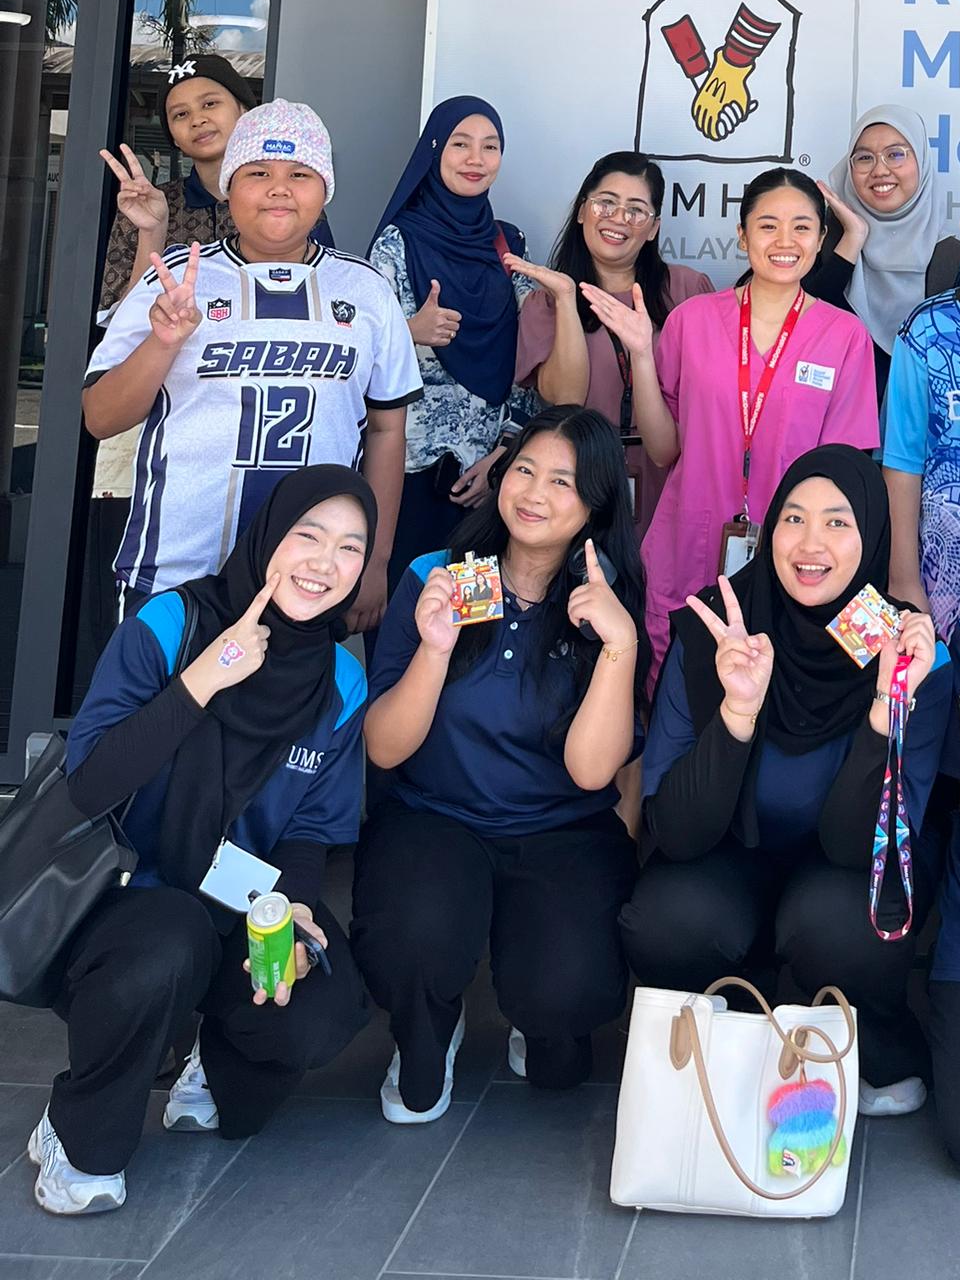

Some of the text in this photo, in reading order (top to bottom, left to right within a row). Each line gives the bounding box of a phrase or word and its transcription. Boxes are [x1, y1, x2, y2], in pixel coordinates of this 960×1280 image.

[671, 182, 751, 218] MH
[210, 308, 229, 320] SBH
[197, 341, 358, 381] SABAH
[232, 383, 317, 469] 12
[288, 745, 325, 769] UMS
